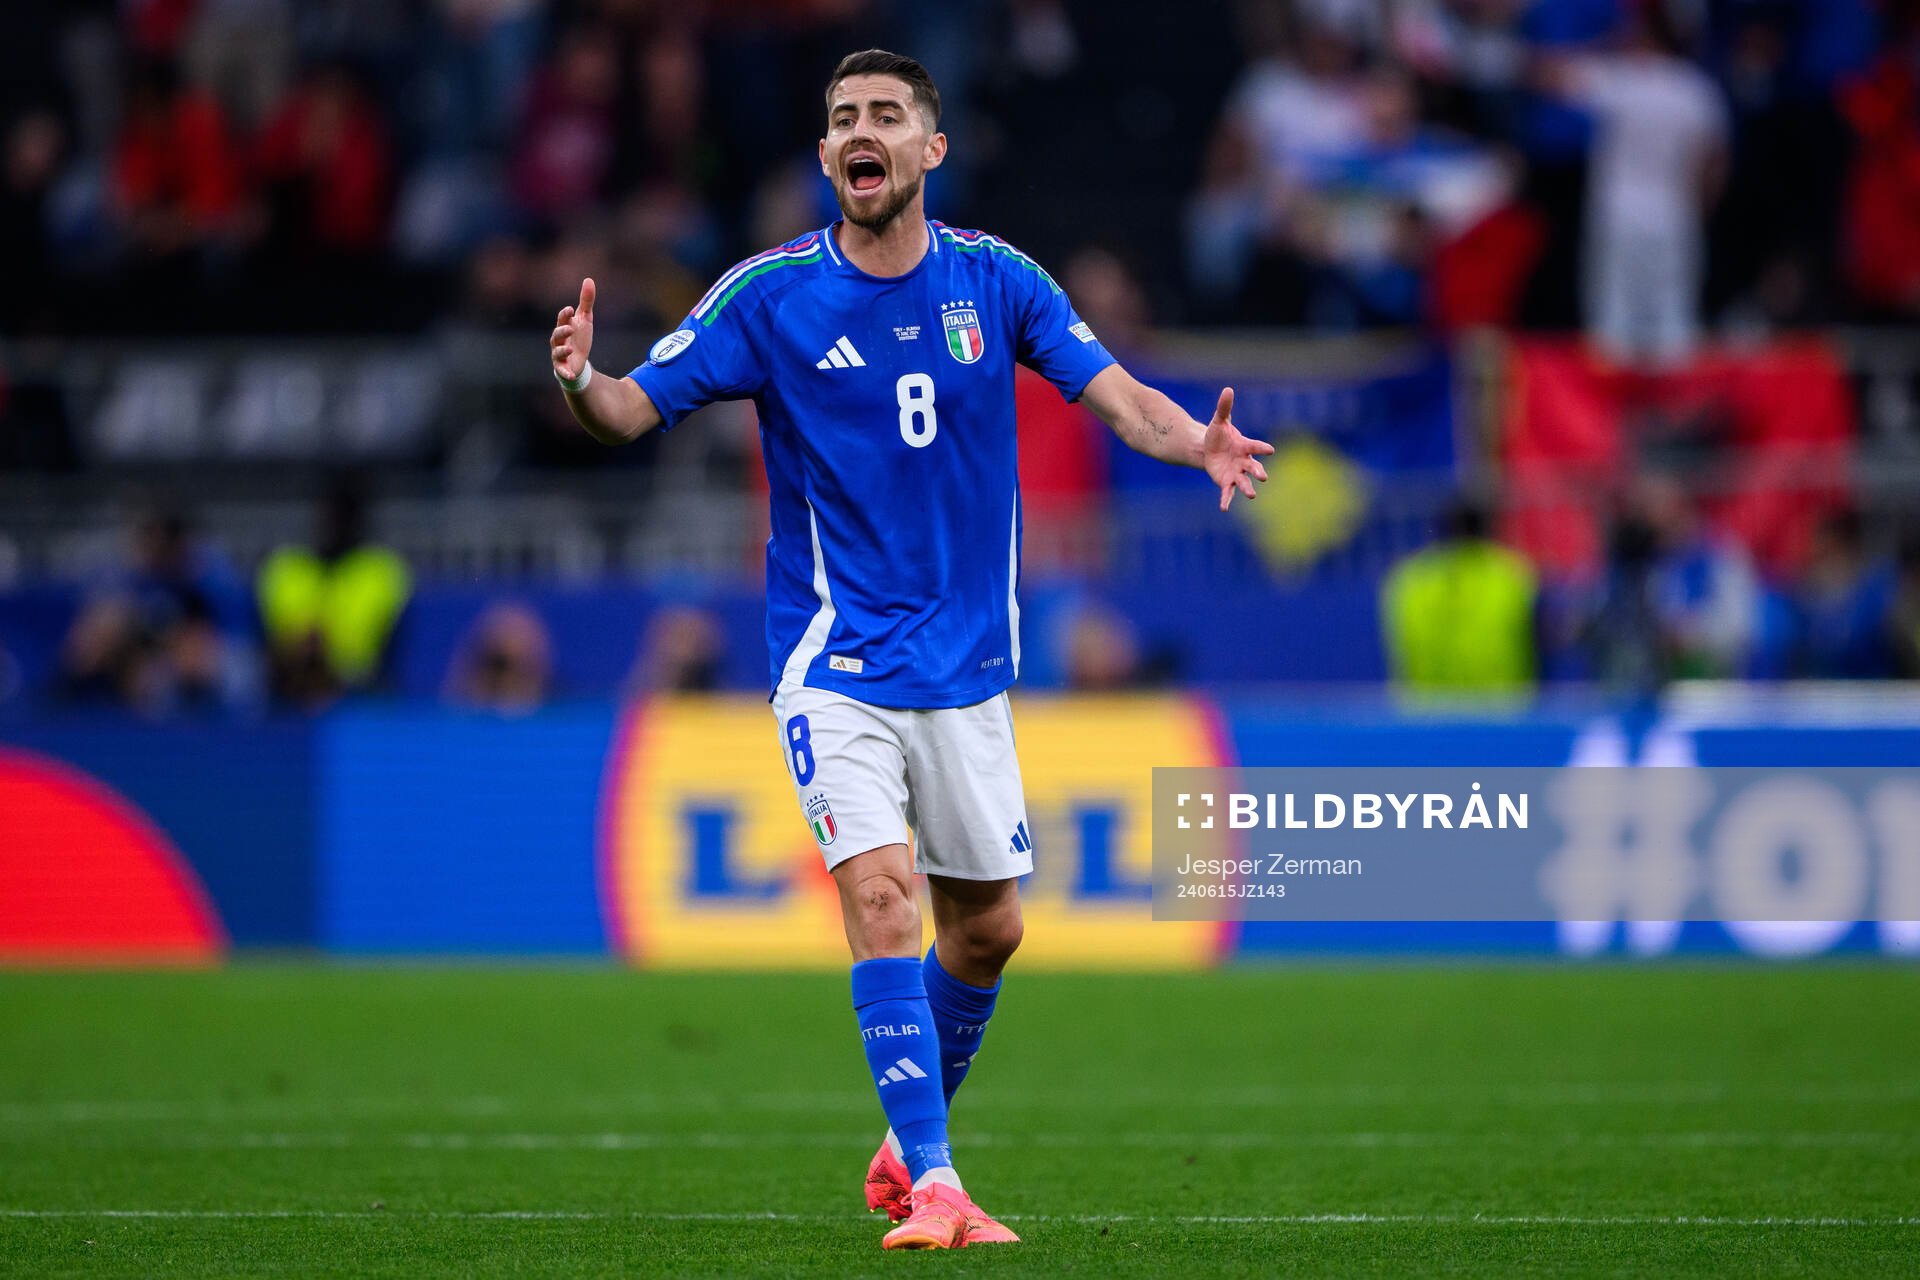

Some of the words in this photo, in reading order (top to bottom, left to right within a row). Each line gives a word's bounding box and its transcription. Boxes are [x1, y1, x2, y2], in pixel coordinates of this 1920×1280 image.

[945, 313, 976, 326] ITALIA
[896, 373, 937, 448] 8
[786, 714, 816, 787] 8
[810, 804, 828, 819] ITALIA
[862, 1024, 920, 1041] ITALIA
